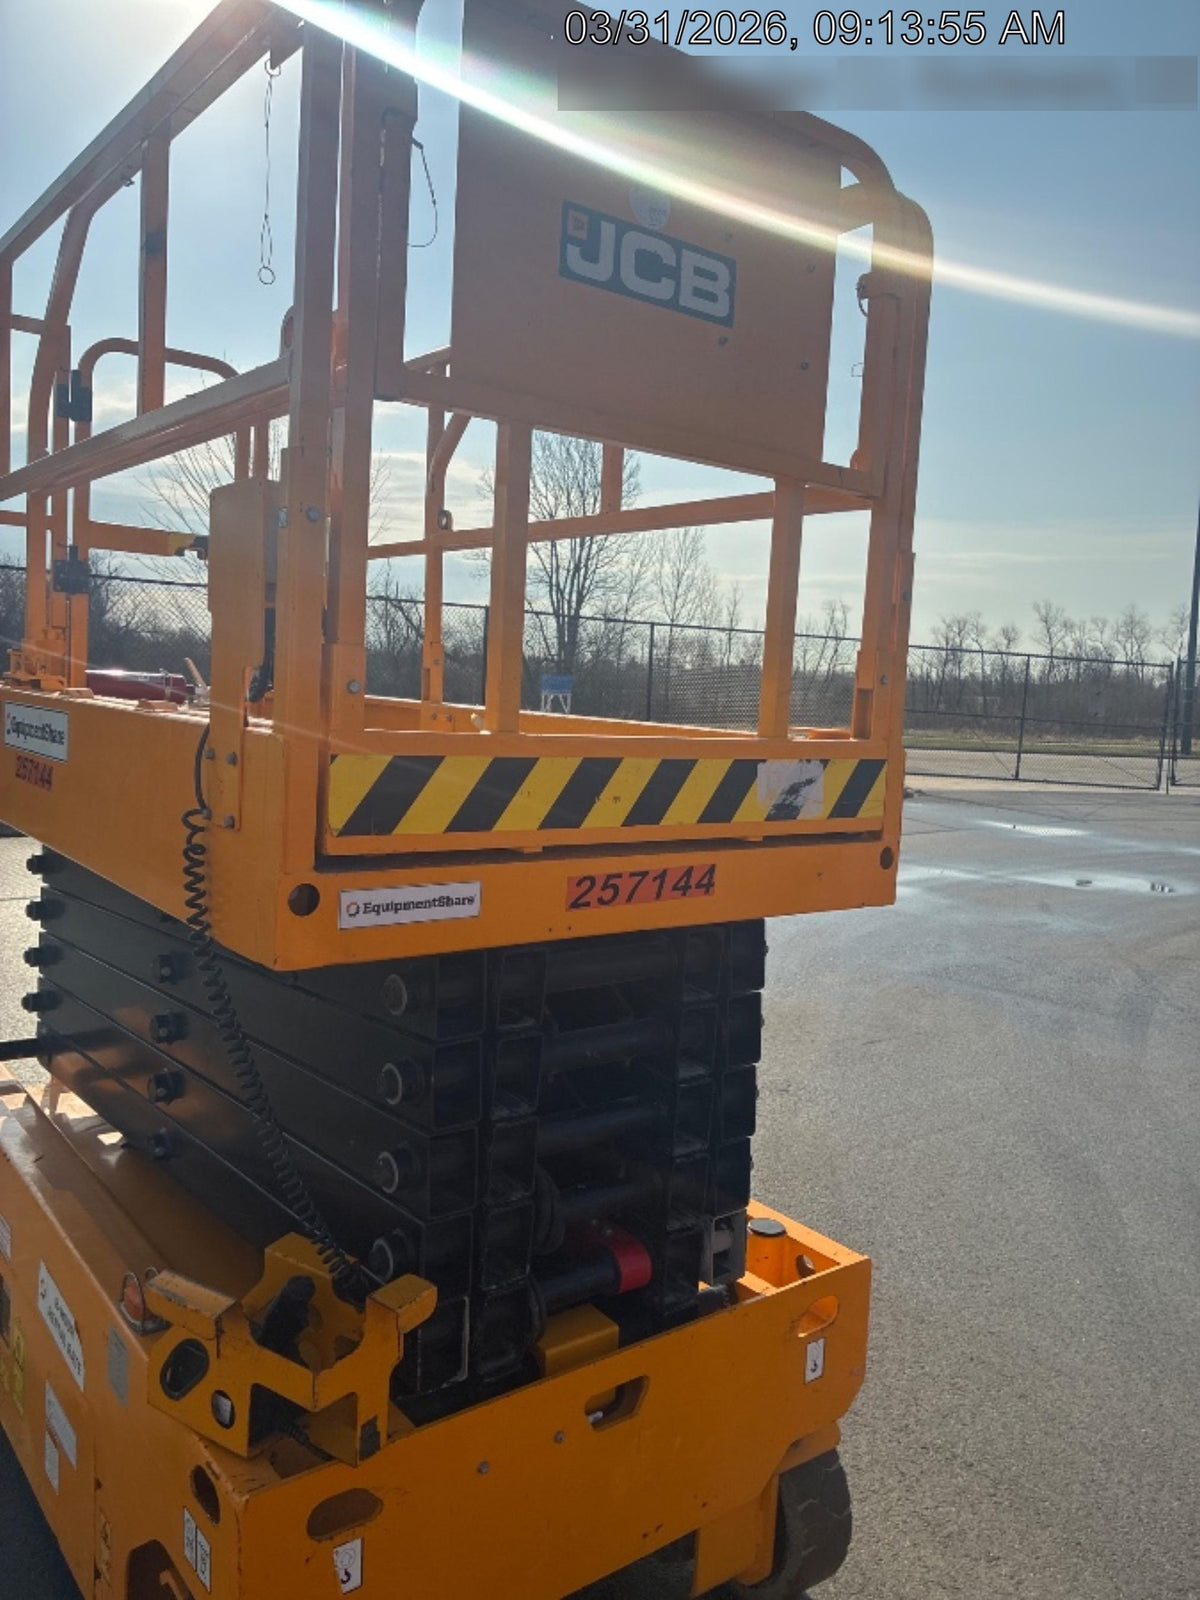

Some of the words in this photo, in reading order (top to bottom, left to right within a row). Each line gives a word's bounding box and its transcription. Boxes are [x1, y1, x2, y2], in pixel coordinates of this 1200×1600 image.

[566, 220, 731, 318] JCB
[15, 754, 53, 790] 257144
[361, 893, 476, 916] EquipmentShare
[569, 864, 717, 909] 257144
